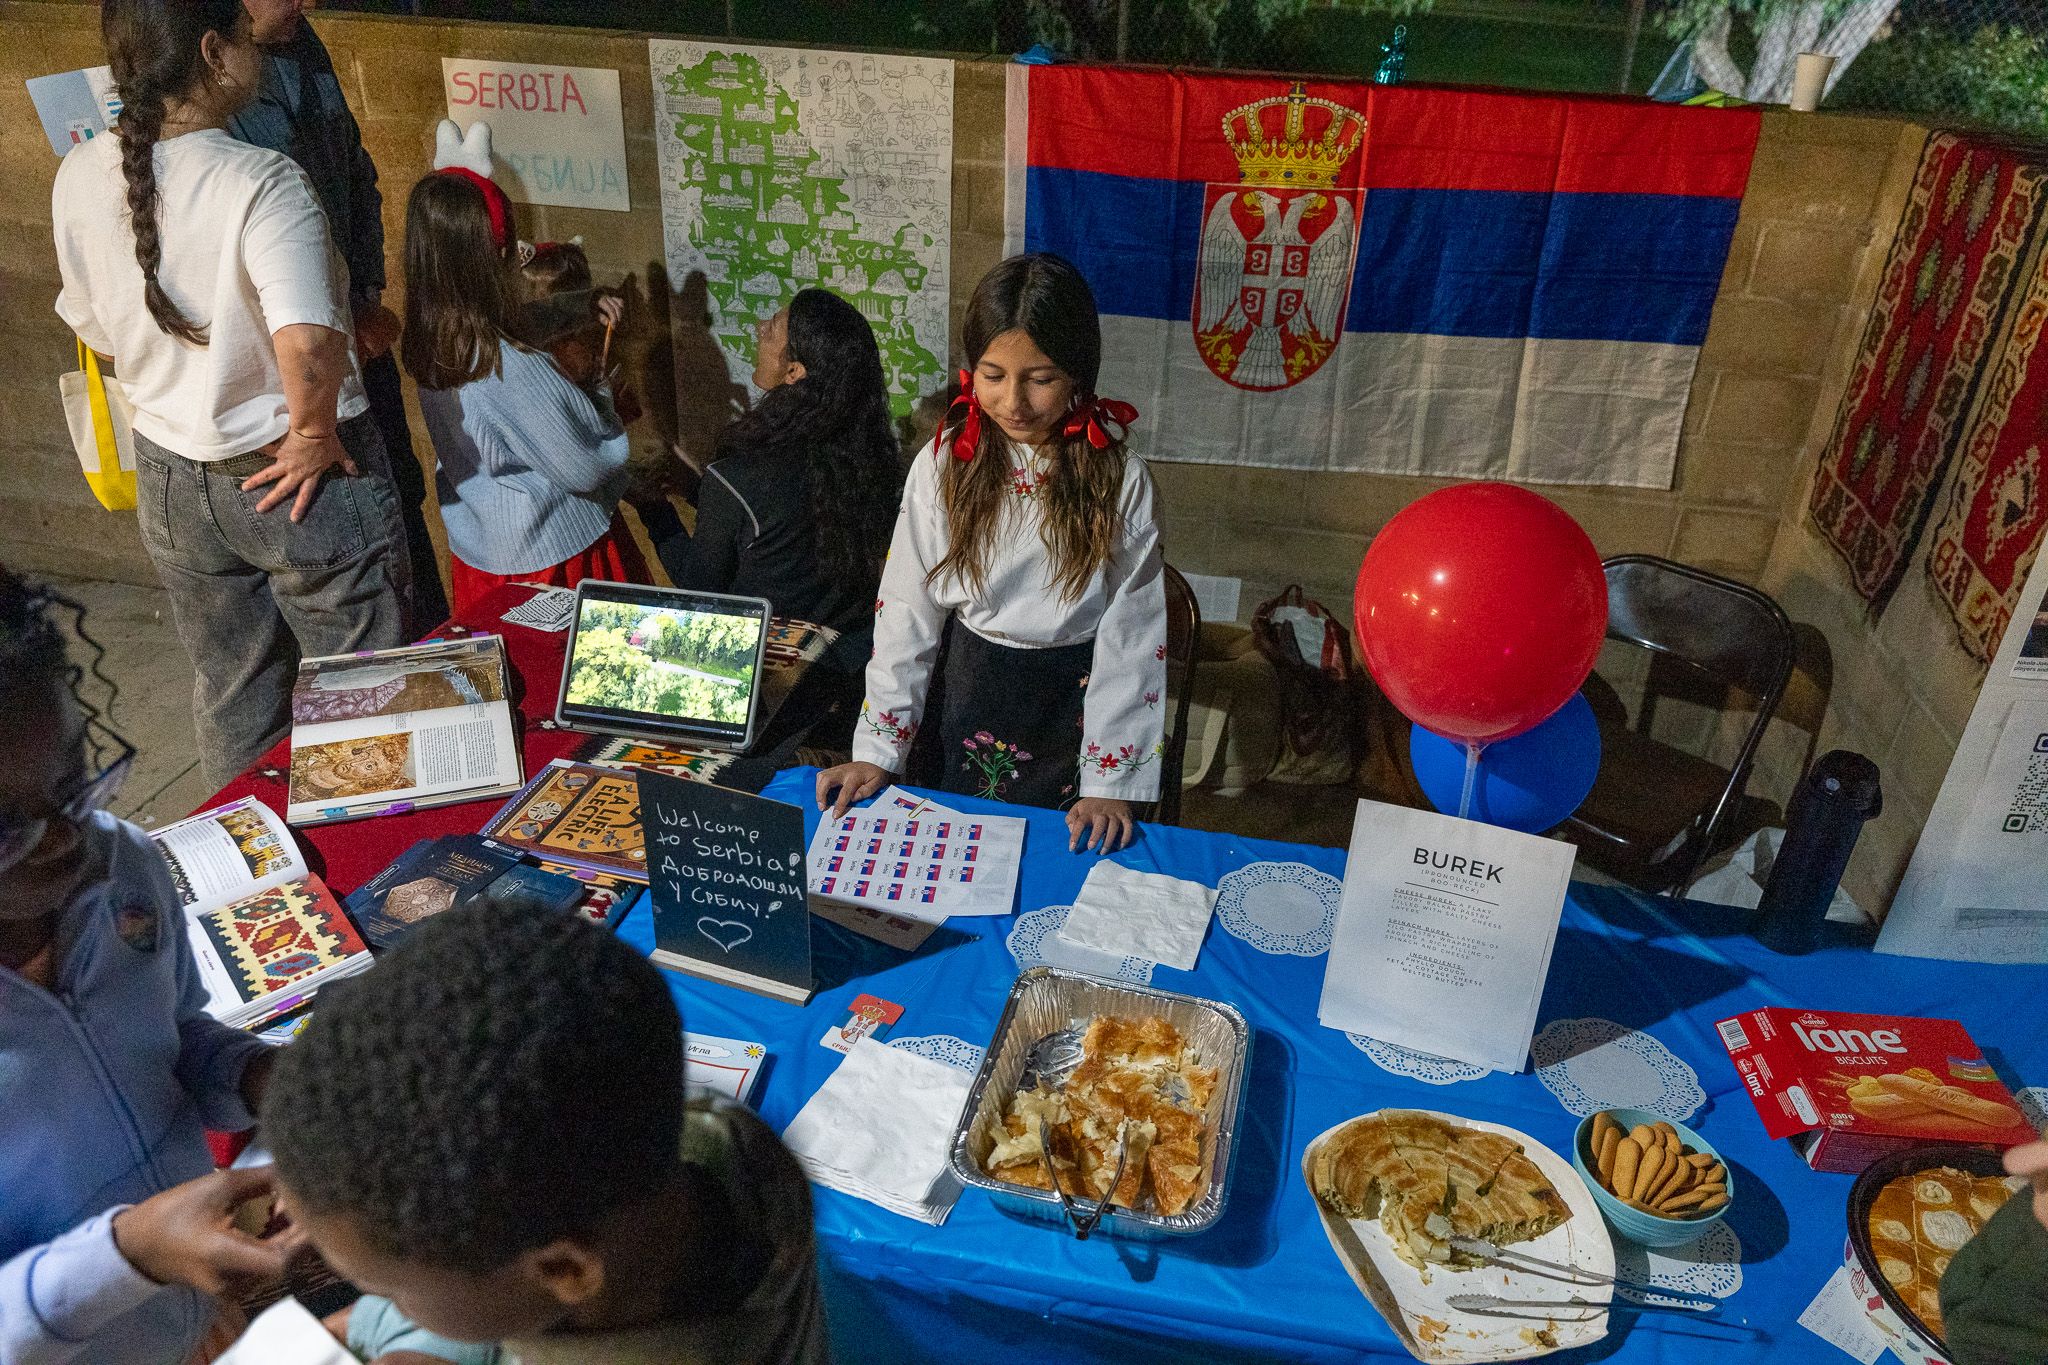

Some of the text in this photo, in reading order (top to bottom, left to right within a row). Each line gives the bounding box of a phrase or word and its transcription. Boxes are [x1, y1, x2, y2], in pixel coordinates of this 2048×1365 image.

[452, 72, 587, 116] SERBIA
[509, 153, 621, 194] РБИЈА
[556, 784, 622, 842] ELECTRIC
[582, 795, 630, 836] A LIFE
[656, 802, 760, 843] Welcome
[656, 832, 800, 876] to Serbia!
[1413, 847, 1504, 884] BUREK
[1393, 892, 1489, 920] SAVORY BALKAN PASTRY
[1394, 887, 1423, 898] CHEESE
[1390, 903, 1419, 914] LAYERS
[1392, 898, 1502, 929] FILLED WITH SALTY CHEESE
[1385, 928, 1417, 940] AROUND
[1428, 939, 1447, 947] RICH
[1450, 945, 1481, 956] FILLING
[1388, 918, 1421, 930] SPINACH
[1456, 935, 1486, 946] LAYERS
[1407, 928, 1435, 938] PASTRY
[1439, 936, 1477, 949] WRAPPED
[1383, 934, 1418, 946] SPINACH
[1440, 948, 1470, 959] CHEESE
[1386, 957, 1404, 965] FETA
[1415, 965, 1449, 977] COTTAGE
[1453, 974, 1483, 986] CHEESE
[1402, 967, 1464, 987] MELTED BUTTER
[1405, 956, 1465, 976] PHYLLO DOUGH
[1835, 1056, 1888, 1064] BISCUITS
[1745, 1072, 1765, 1098] lane
